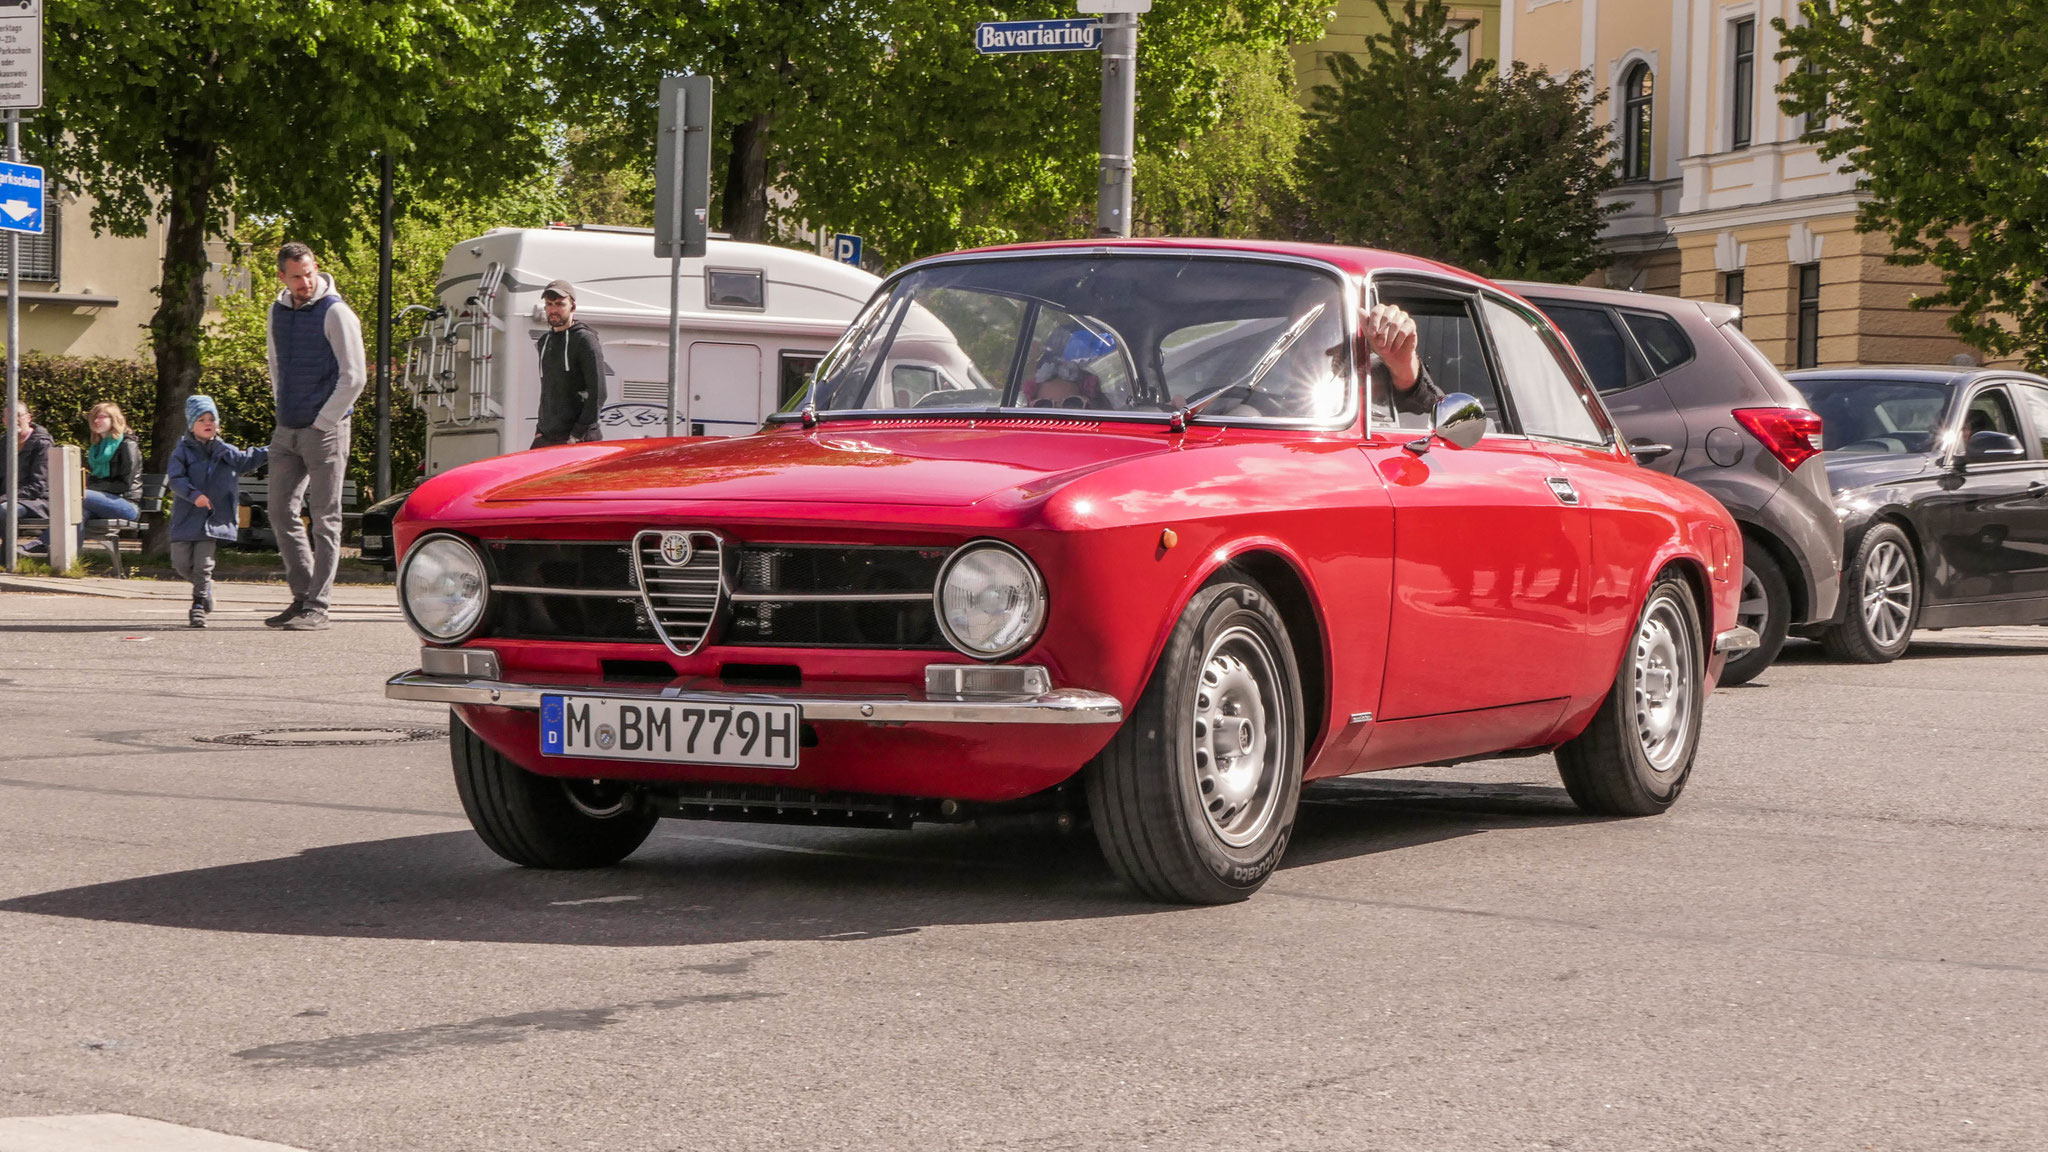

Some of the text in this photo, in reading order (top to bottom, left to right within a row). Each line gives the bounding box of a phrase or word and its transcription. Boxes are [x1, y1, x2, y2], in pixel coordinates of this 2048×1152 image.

[981, 23, 1095, 48] Bavariaring
[838, 239, 854, 262] P
[547, 731, 558, 744] D
[566, 702, 791, 758] M BM 779H
